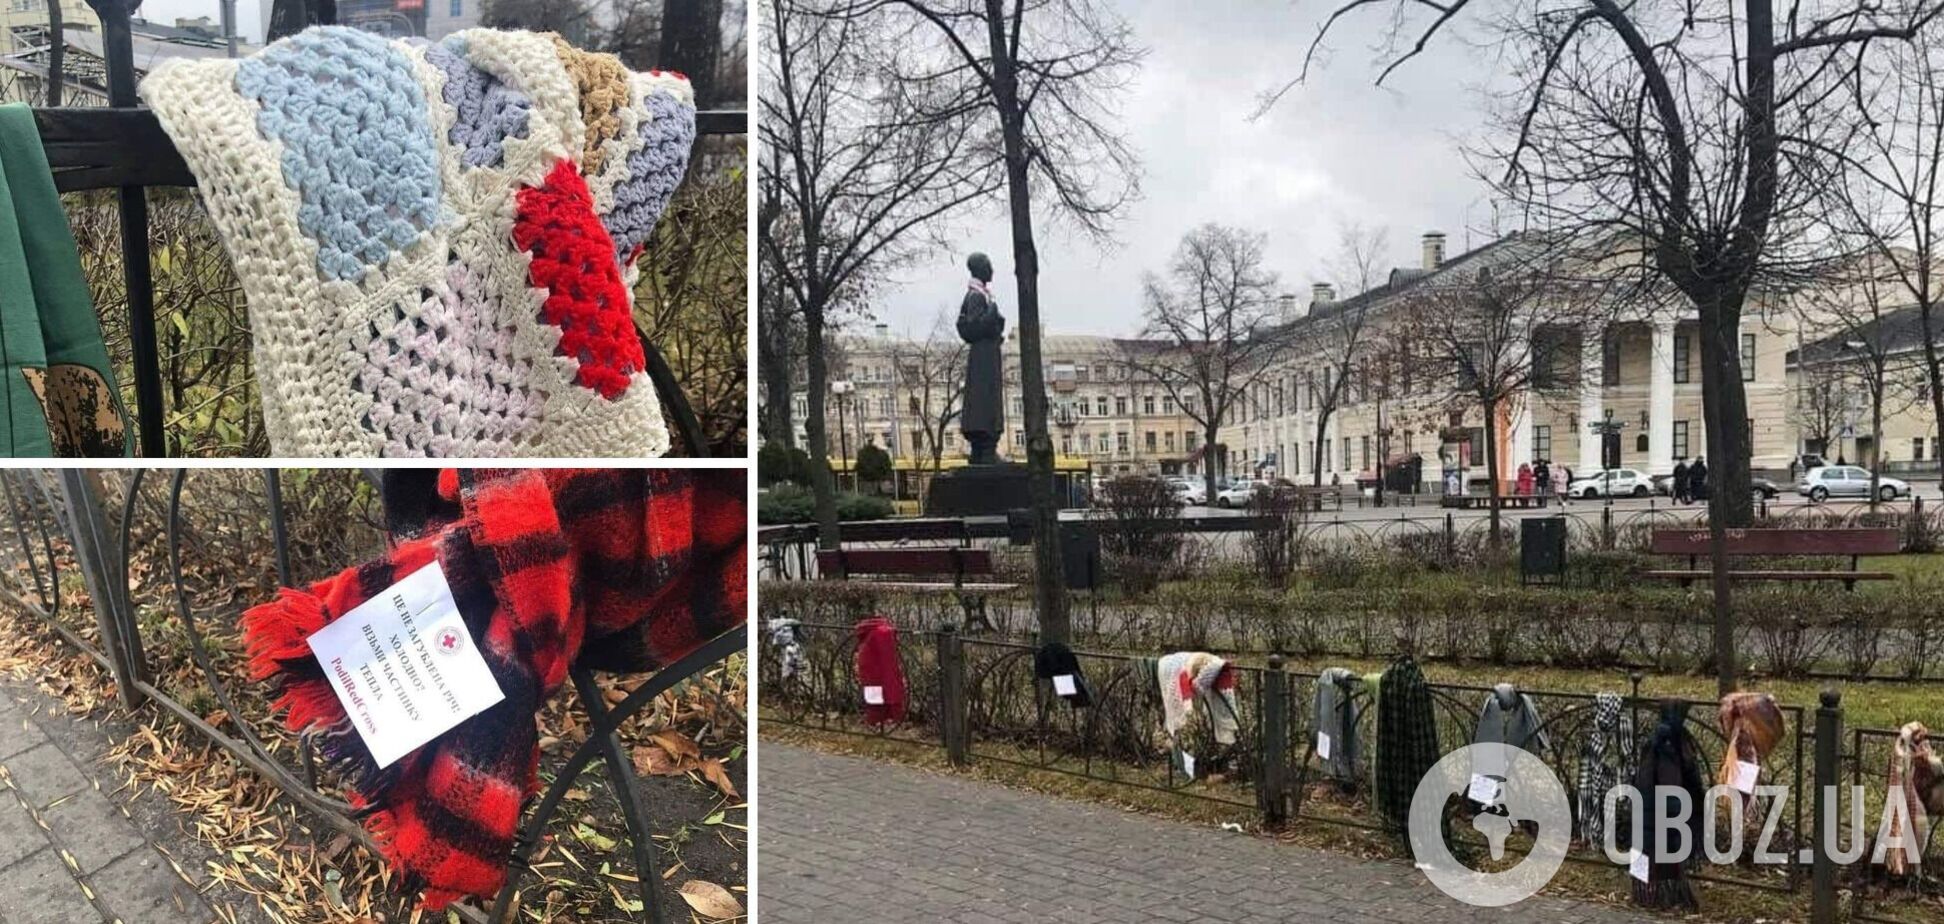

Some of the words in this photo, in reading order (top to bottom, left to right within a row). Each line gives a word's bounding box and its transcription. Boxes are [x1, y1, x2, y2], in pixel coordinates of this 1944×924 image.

[392, 594, 407, 612] ЦЕ
[399, 611, 414, 628] НЕ
[359, 662, 383, 701] ТЕПЛА
[361, 624, 387, 663] ВІЗЬМИ
[382, 662, 421, 722] ЧАСТИНКУ
[388, 633, 426, 692] ХОЛОДНО?
[407, 626, 446, 691] ЗАГУБЛЕНА
[331, 657, 377, 735] PodilRedCross
[443, 689, 461, 713] РІЧ!
